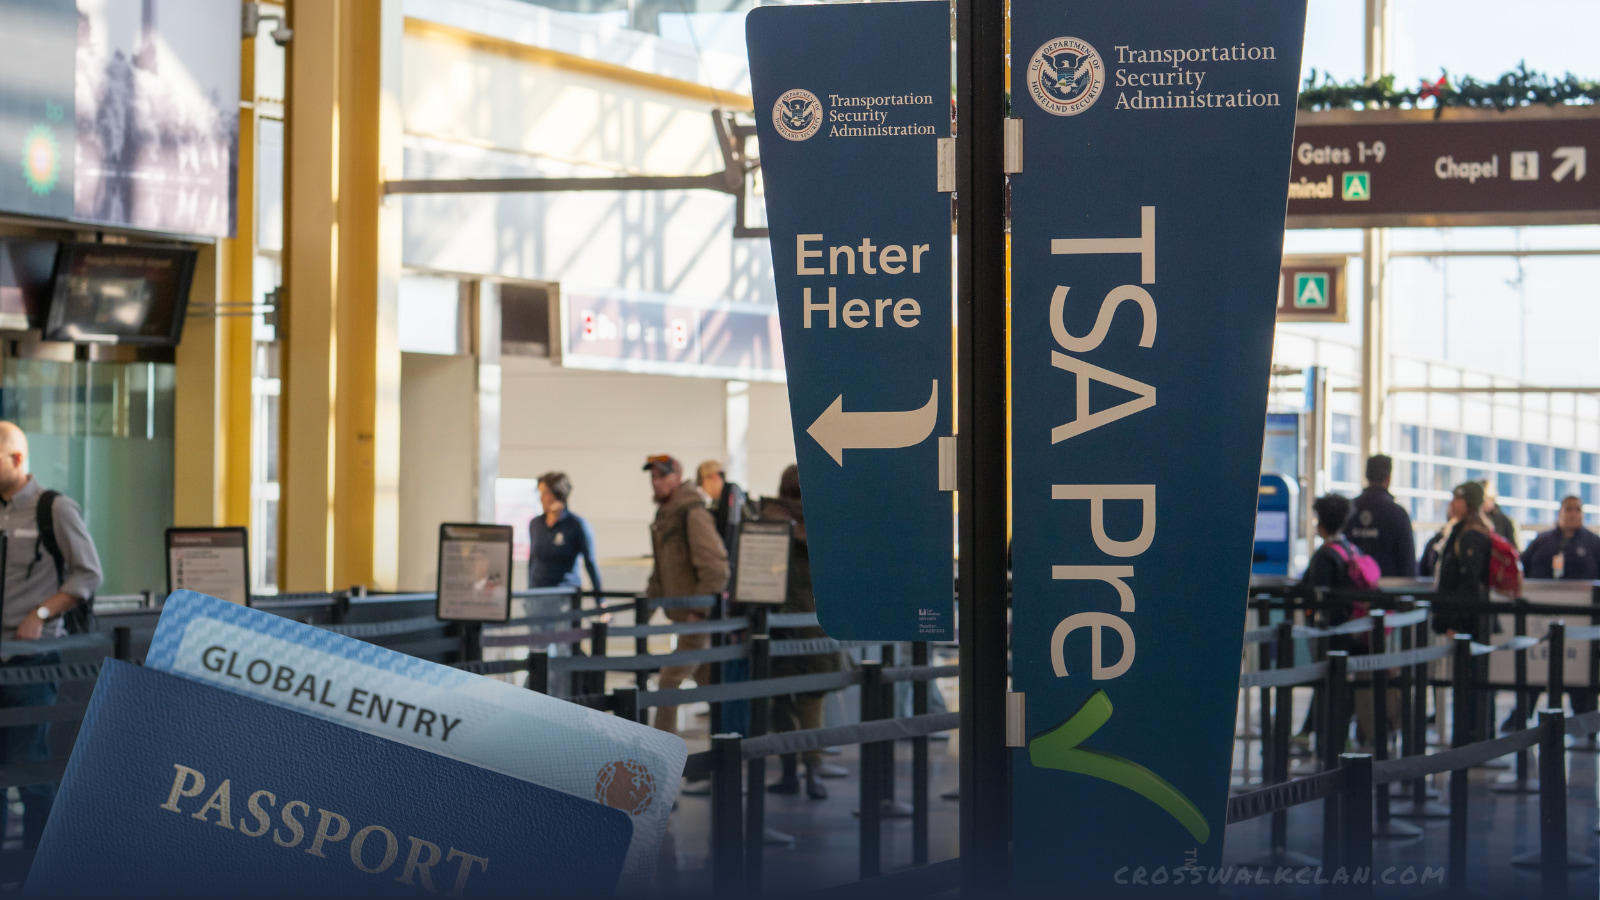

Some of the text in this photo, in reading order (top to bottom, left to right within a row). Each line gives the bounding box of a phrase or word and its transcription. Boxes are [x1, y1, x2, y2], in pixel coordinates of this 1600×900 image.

[1043, 40, 1095, 59] DEPARTMENT
[1092, 59, 1101, 71] OF
[1115, 43, 1277, 67] Transportation
[1115, 68, 1206, 91] Security
[829, 93, 933, 109] Transportation
[1031, 79, 1101, 113] HOMELAND SECURITY
[1115, 89, 1281, 109] Administration
[829, 109, 888, 124] Security
[829, 123, 936, 138] Administration
[1297, 140, 1386, 165] Gates 1-9
[1434, 154, 1499, 184] Chapel
[796, 234, 930, 276] Enter
[803, 287, 922, 329] Here
[1049, 206, 1158, 680] TSA Pre
[202, 646, 462, 742] GLOBAL ENTRY
[160, 762, 489, 898] PASSPORT
